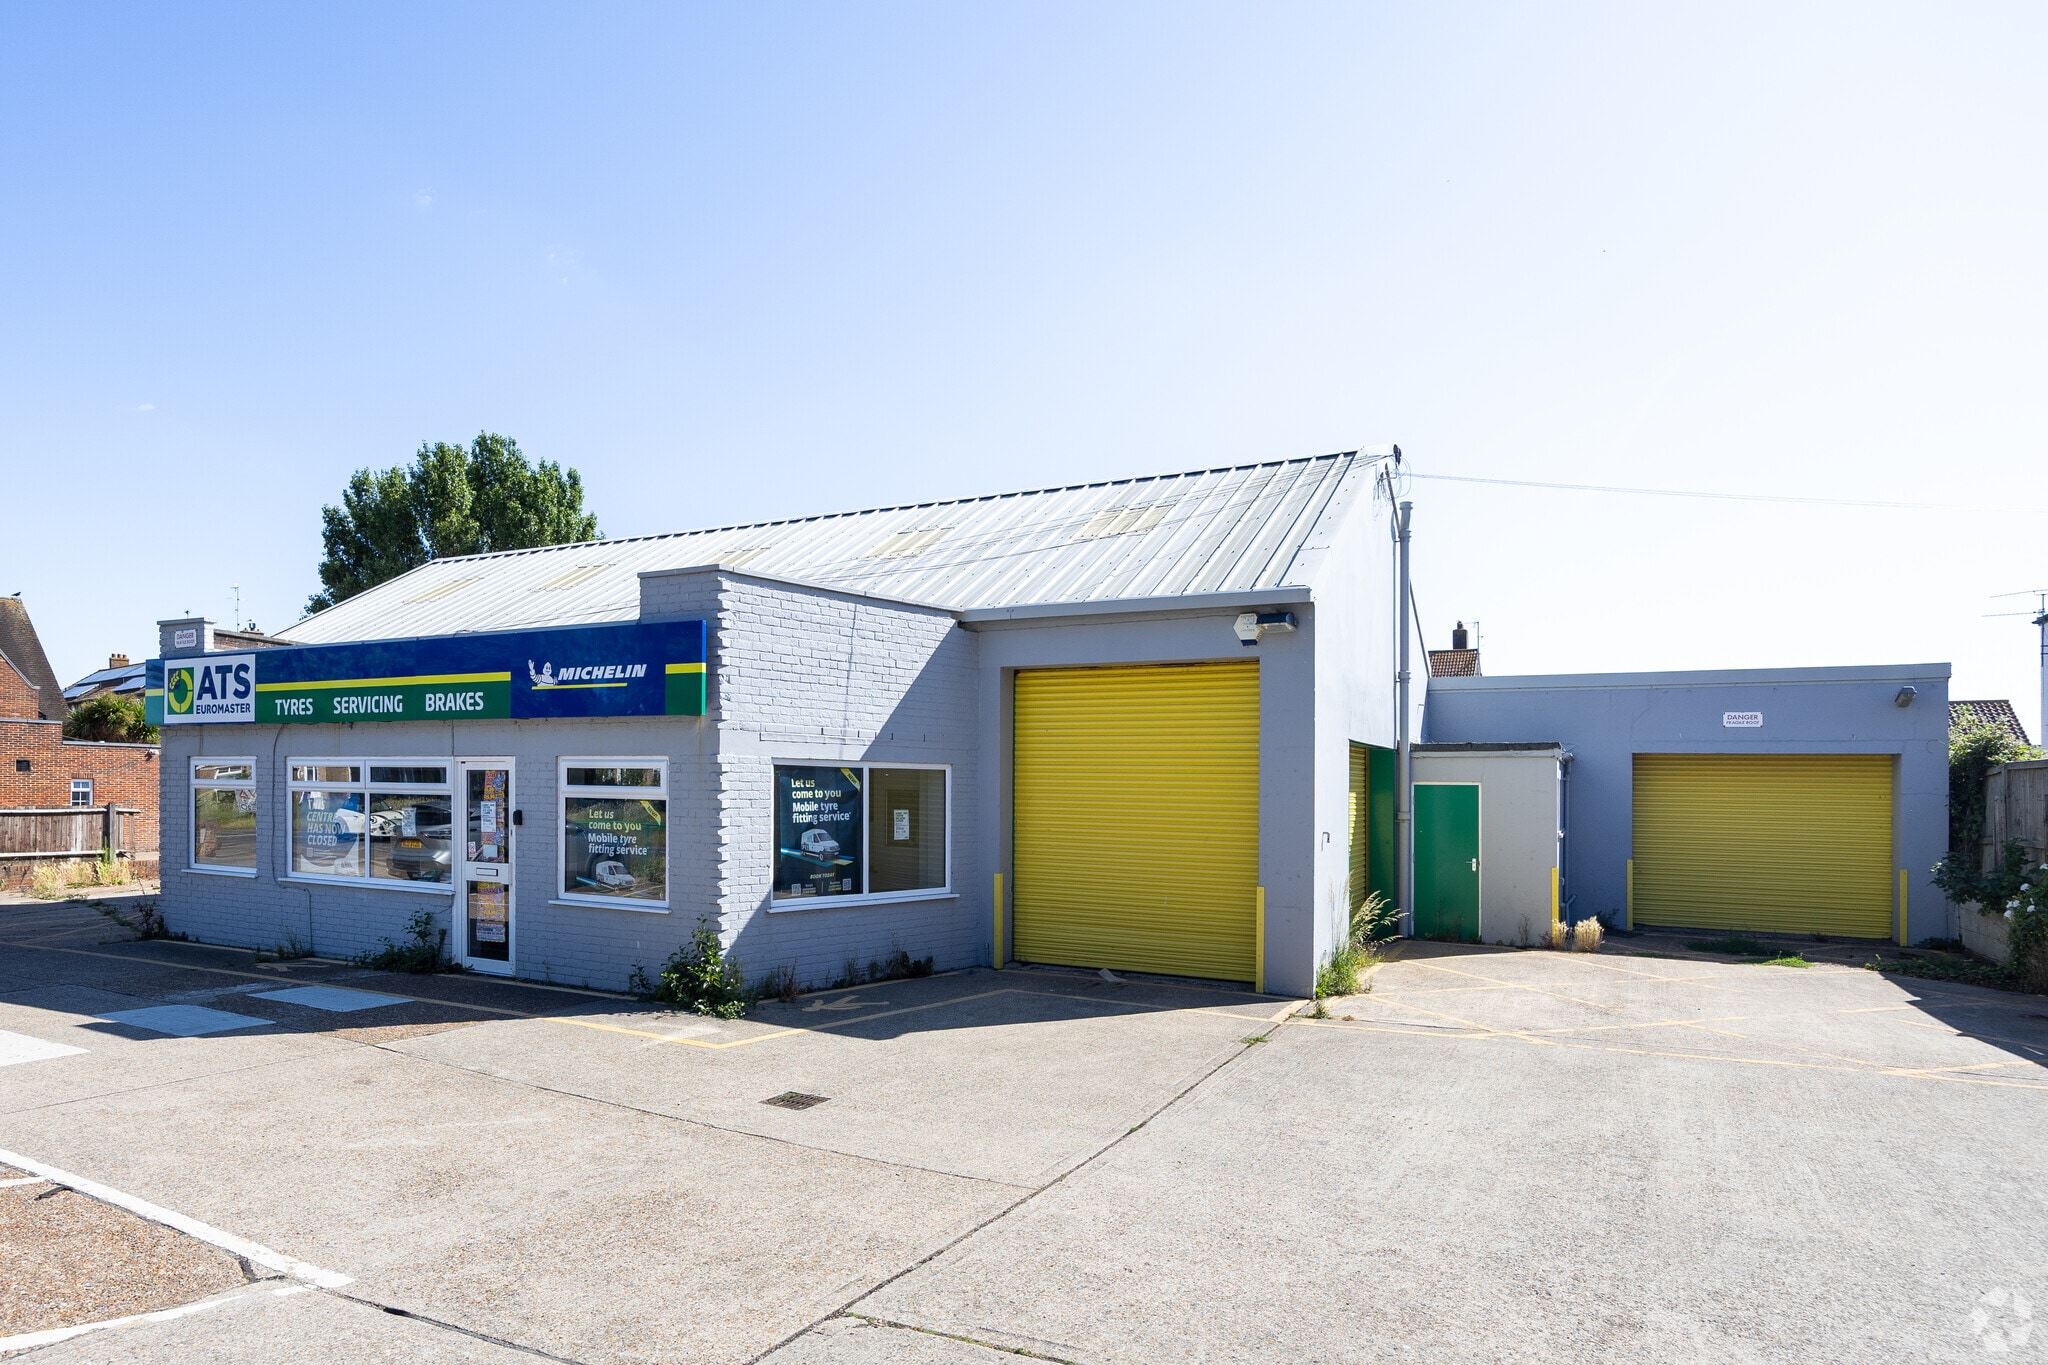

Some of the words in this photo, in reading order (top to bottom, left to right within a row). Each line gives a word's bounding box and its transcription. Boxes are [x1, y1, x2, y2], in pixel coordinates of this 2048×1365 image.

[557, 664, 647, 681] MICHELIN
[197, 663, 251, 700] ATS
[196, 703, 251, 715] EUROMASTER
[275, 698, 313, 716] TYRES
[333, 694, 403, 714] SERVICING
[425, 691, 484, 712] BRAKES
[791, 778, 804, 788] Let
[805, 779, 815, 788] us
[792, 790, 813, 799] come
[814, 789, 823, 798] to
[824, 789, 842, 800] you
[308, 799, 326, 810] THIS
[792, 801, 818, 812] Mobile
[820, 802, 839, 813] tyre
[589, 809, 603, 819] Let
[604, 810, 615, 819] us
[792, 812, 818, 825] fitting
[307, 823, 324, 833] HAS
[325, 824, 347, 835] NOW
[588, 821, 611, 830] come
[612, 821, 623, 831] to
[624, 822, 642, 833] you
[307, 835, 337, 847] CLOSED
[588, 833, 618, 843] Mobile
[620, 834, 637, 846] tyre
[588, 843, 615, 857] fitting
